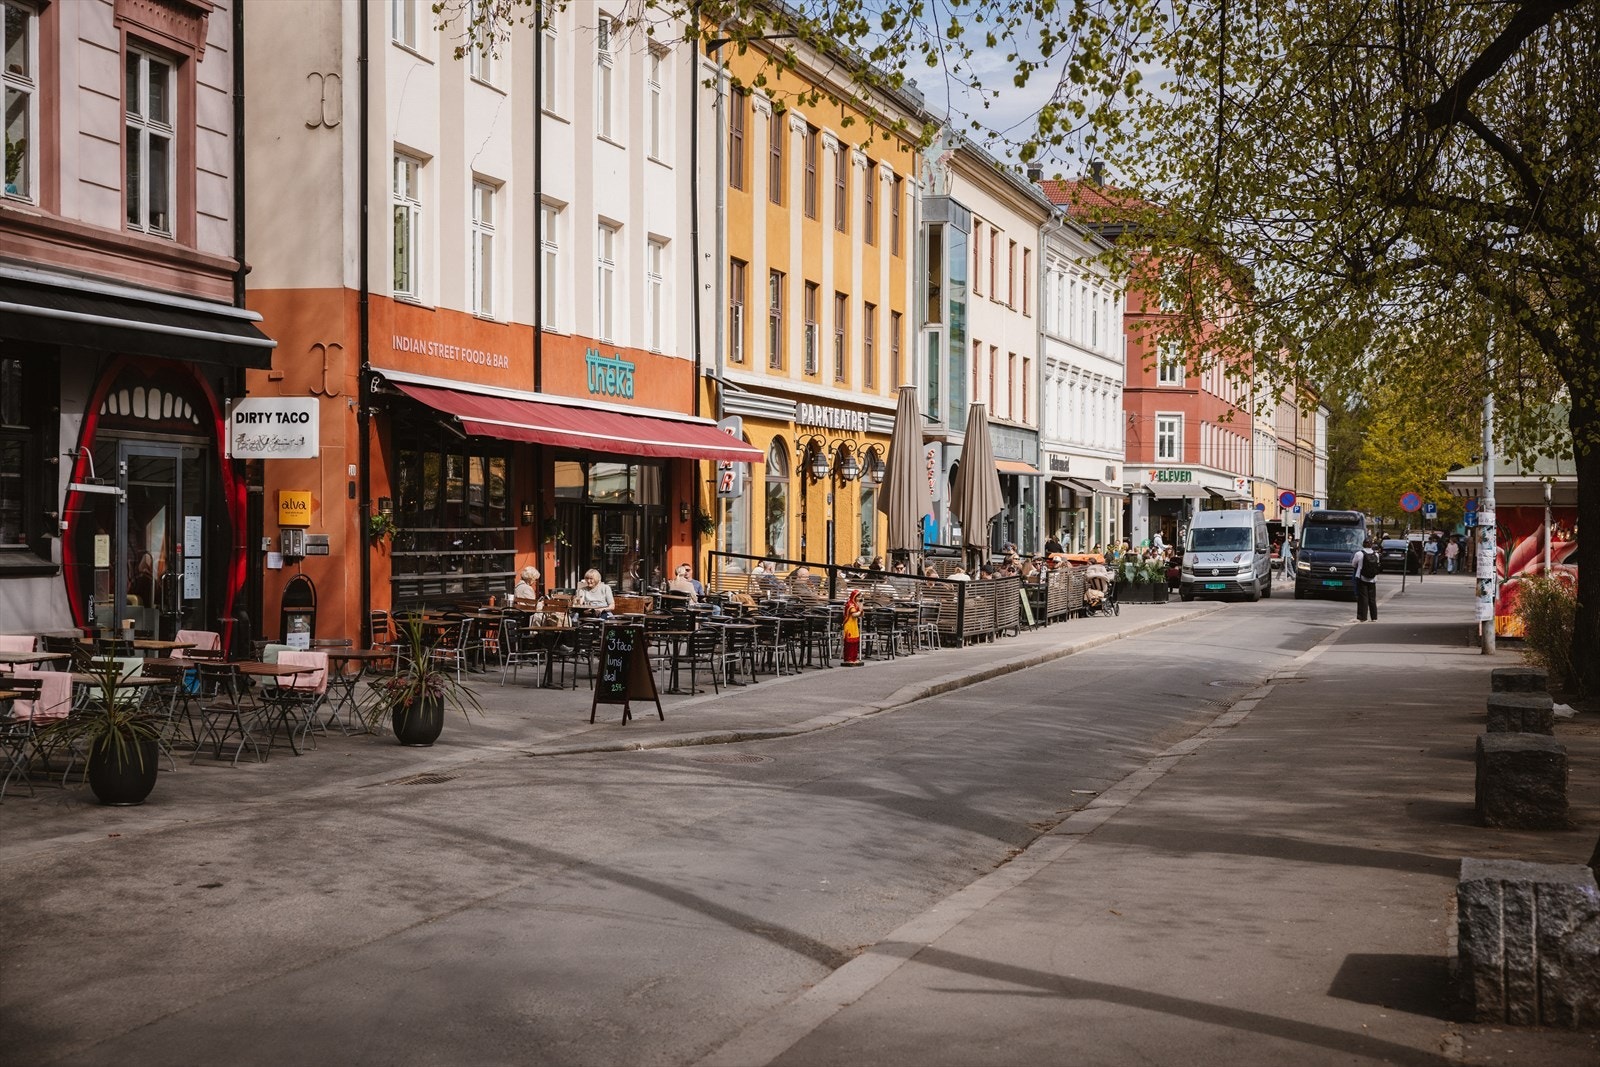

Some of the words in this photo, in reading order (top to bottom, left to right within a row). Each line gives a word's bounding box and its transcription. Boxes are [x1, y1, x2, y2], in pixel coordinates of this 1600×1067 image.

[392, 335, 426, 355] INDIAN
[428, 341, 460, 361] STREET
[461, 347, 485, 365] FOOD
[486, 352, 492, 367] &
[493, 353, 509, 369] BAR
[236, 412, 272, 424] DIRTY
[275, 412, 309, 424] TACO
[801, 402, 868, 432] PARKTEATRET
[281, 498, 306, 510] alva
[1427, 504, 1434, 512] P
[608, 639, 616, 651] 3
[603, 670, 616, 681] deal
